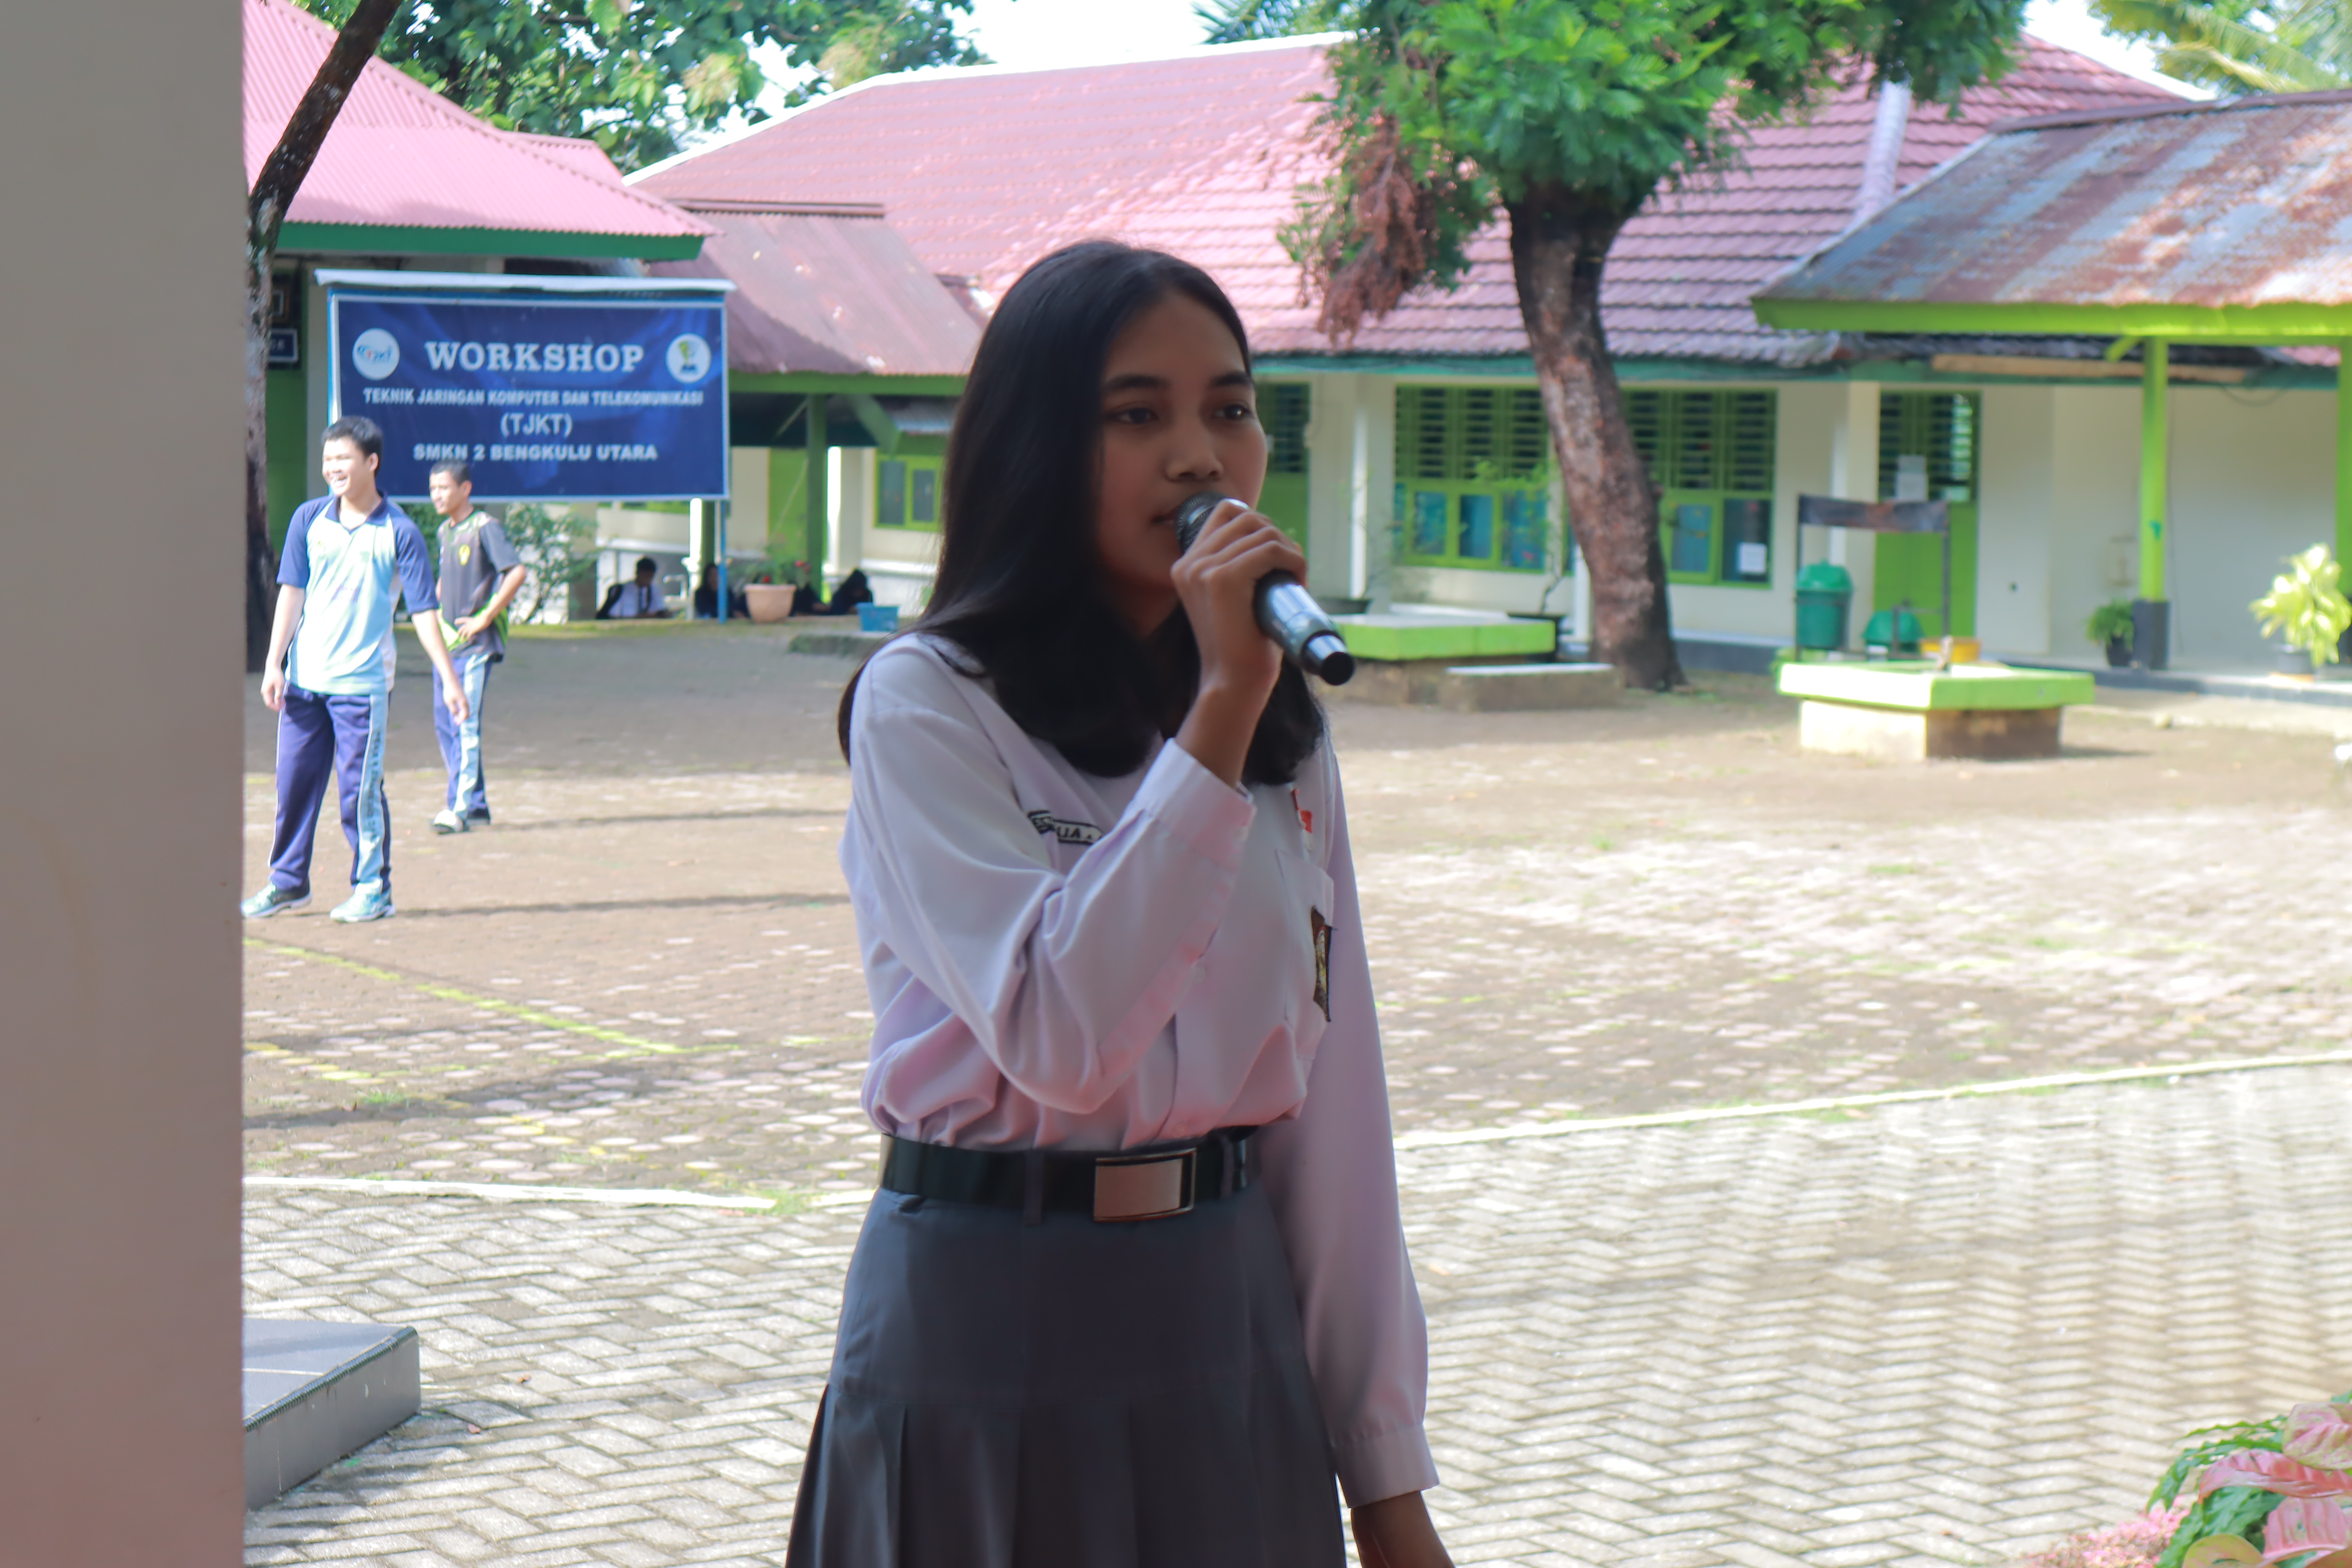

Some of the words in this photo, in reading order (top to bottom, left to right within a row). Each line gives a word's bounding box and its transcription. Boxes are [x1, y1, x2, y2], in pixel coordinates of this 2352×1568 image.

[424, 341, 644, 372] WORKSHOP
[363, 387, 415, 405] TEKNIK
[417, 388, 485, 406] JARINGAN
[488, 389, 559, 407] KOMPUTER
[562, 390, 589, 406] DAN
[591, 391, 704, 407] TELEKOMUNIKASI
[500, 412, 572, 438] (TJKT)
[413, 443, 468, 461] SMKN
[473, 444, 485, 461] 2
[490, 444, 592, 462] BENGKULU
[596, 444, 658, 462] UTARA
